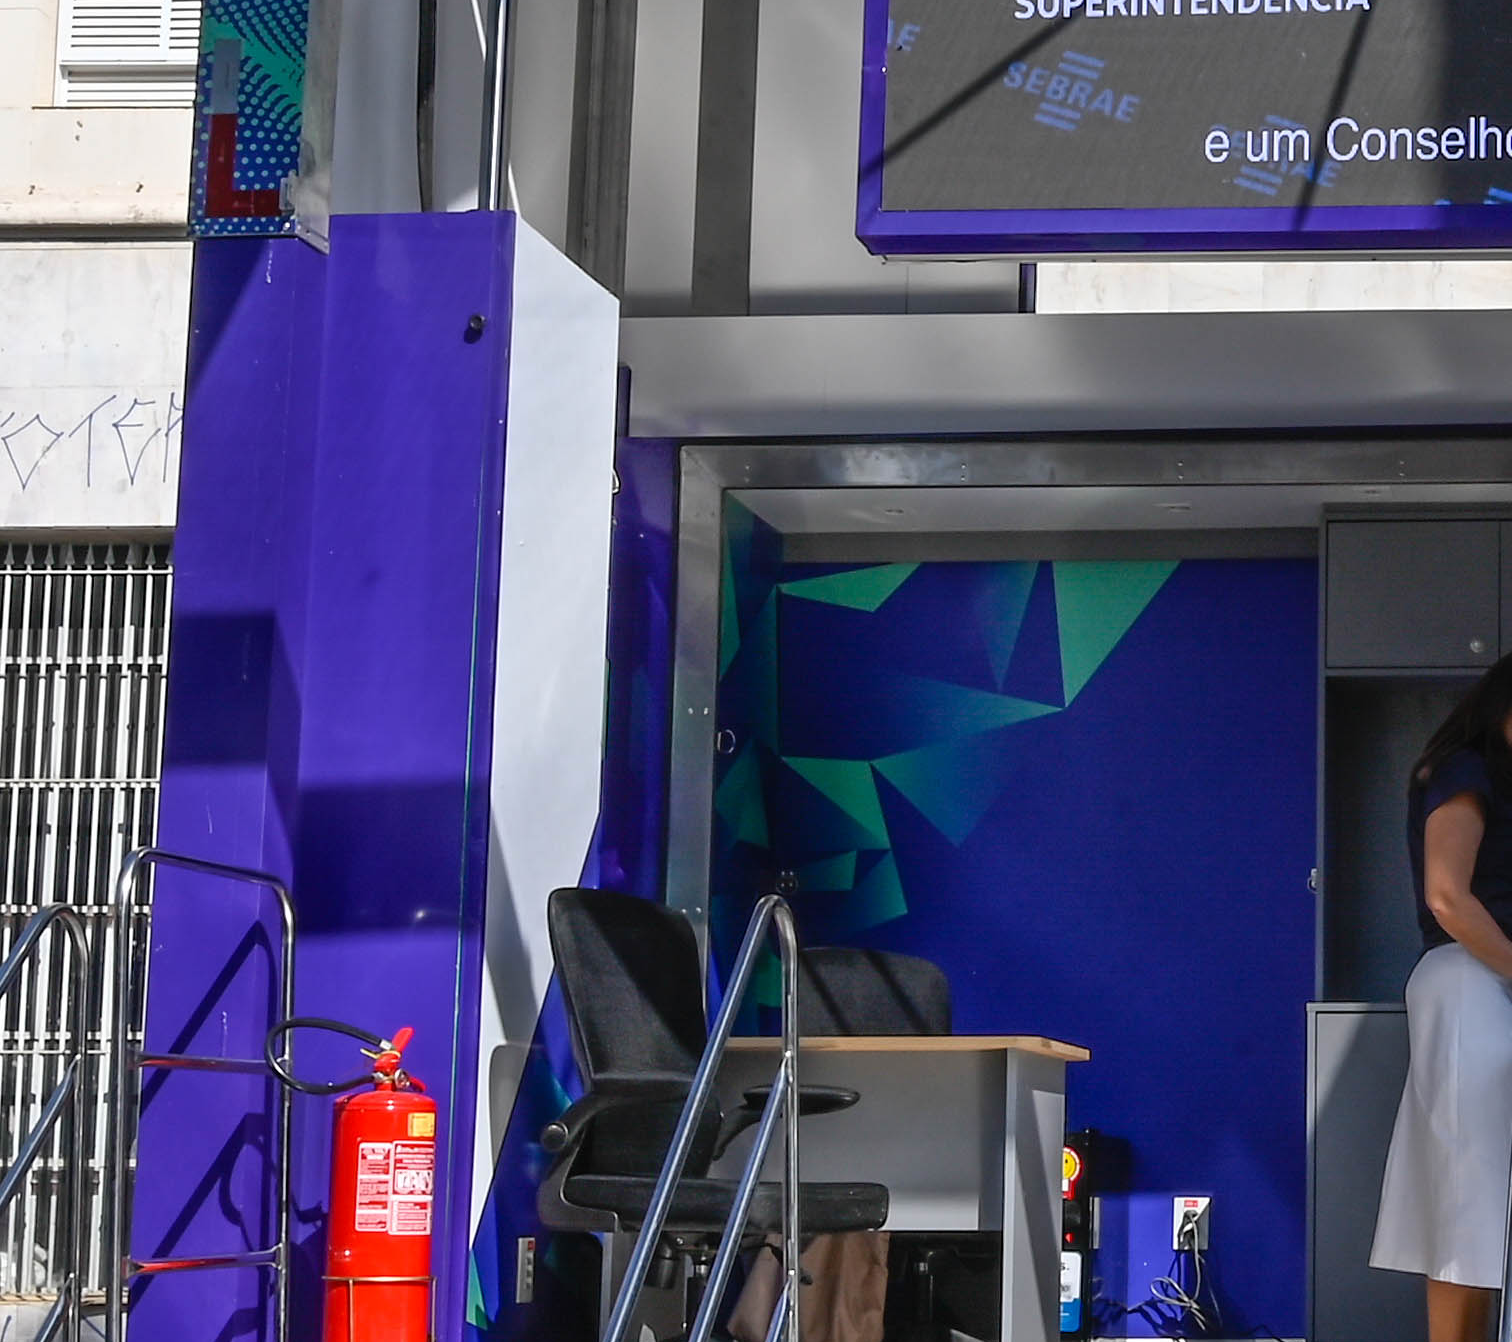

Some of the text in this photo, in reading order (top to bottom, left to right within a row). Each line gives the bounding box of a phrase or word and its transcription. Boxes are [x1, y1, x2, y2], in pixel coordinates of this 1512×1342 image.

[1003, 62, 1140, 123] SEBRAE
[1204, 130, 1230, 163] e
[1246, 130, 1310, 162] um
